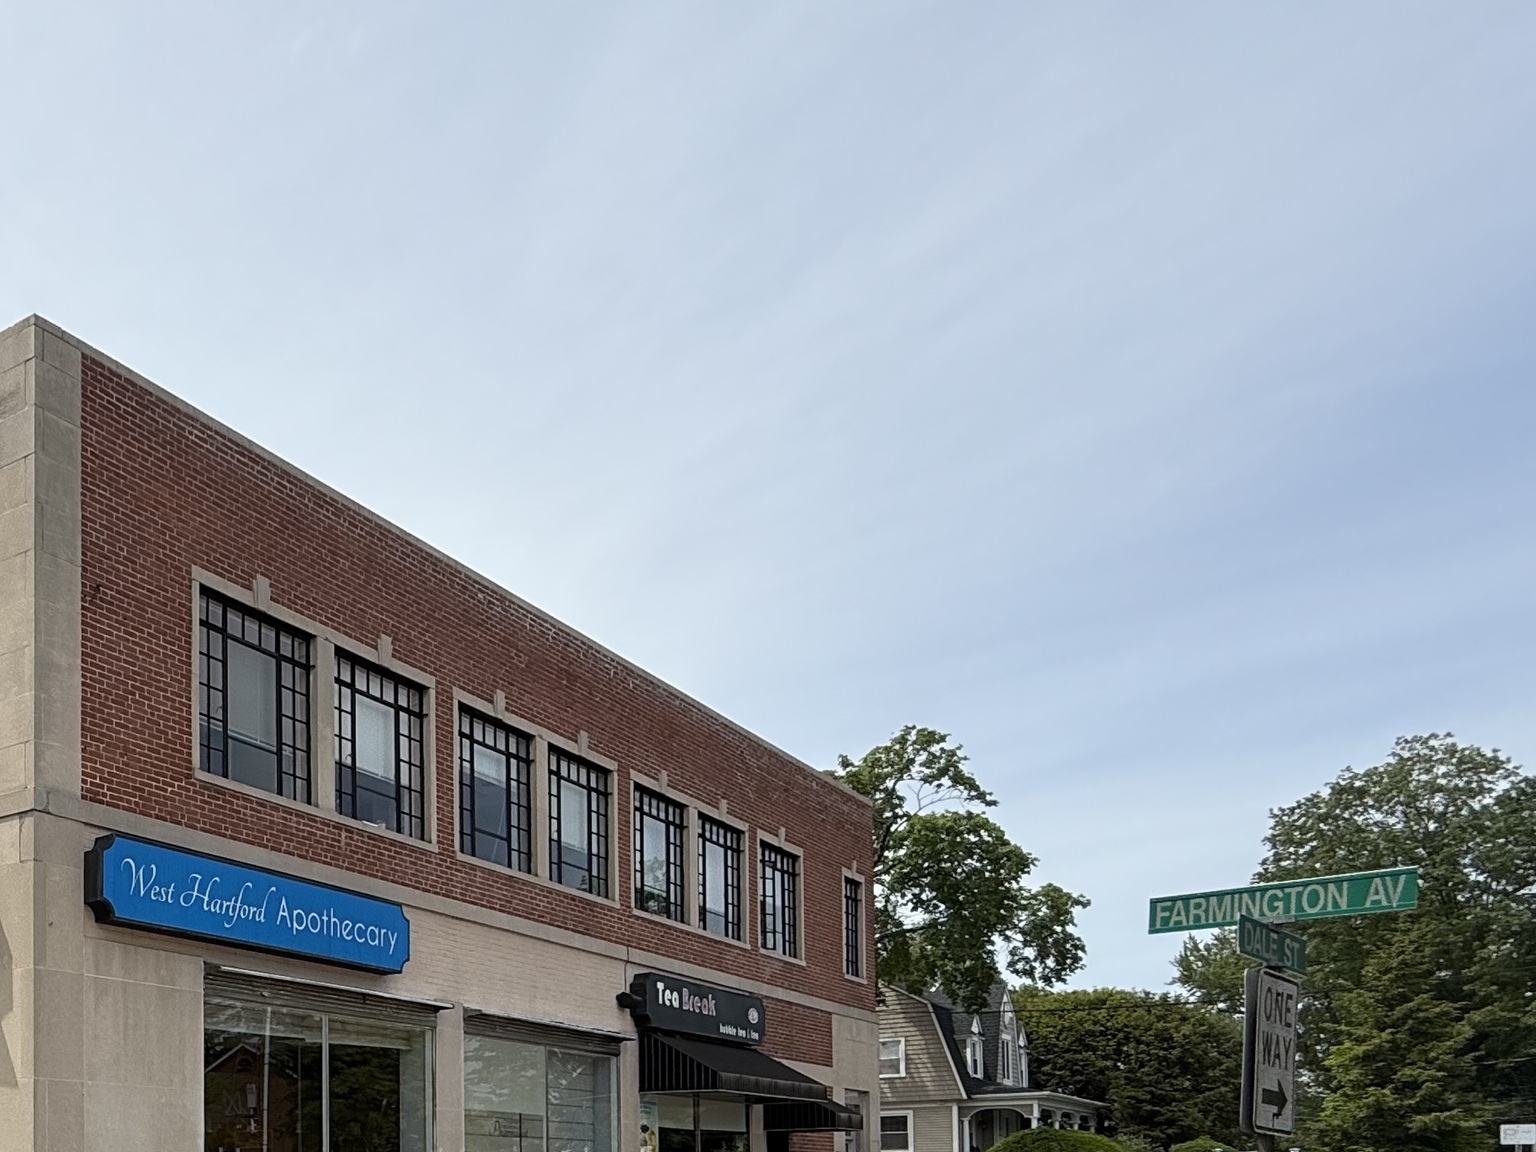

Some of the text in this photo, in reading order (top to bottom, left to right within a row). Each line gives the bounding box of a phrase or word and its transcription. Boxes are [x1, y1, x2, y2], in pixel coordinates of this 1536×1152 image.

[121, 857, 398, 956] West Hartford Apothecary
[1154, 874, 1407, 929] FARMINGTON AV
[1243, 921, 1302, 969] DALE ST
[656, 981, 717, 1017] Tea Break
[1264, 986, 1294, 1029] ONE
[719, 1022, 737, 1036] bubble
[737, 1026, 746, 1038] tea
[1262, 1031, 1293, 1069] WAY
